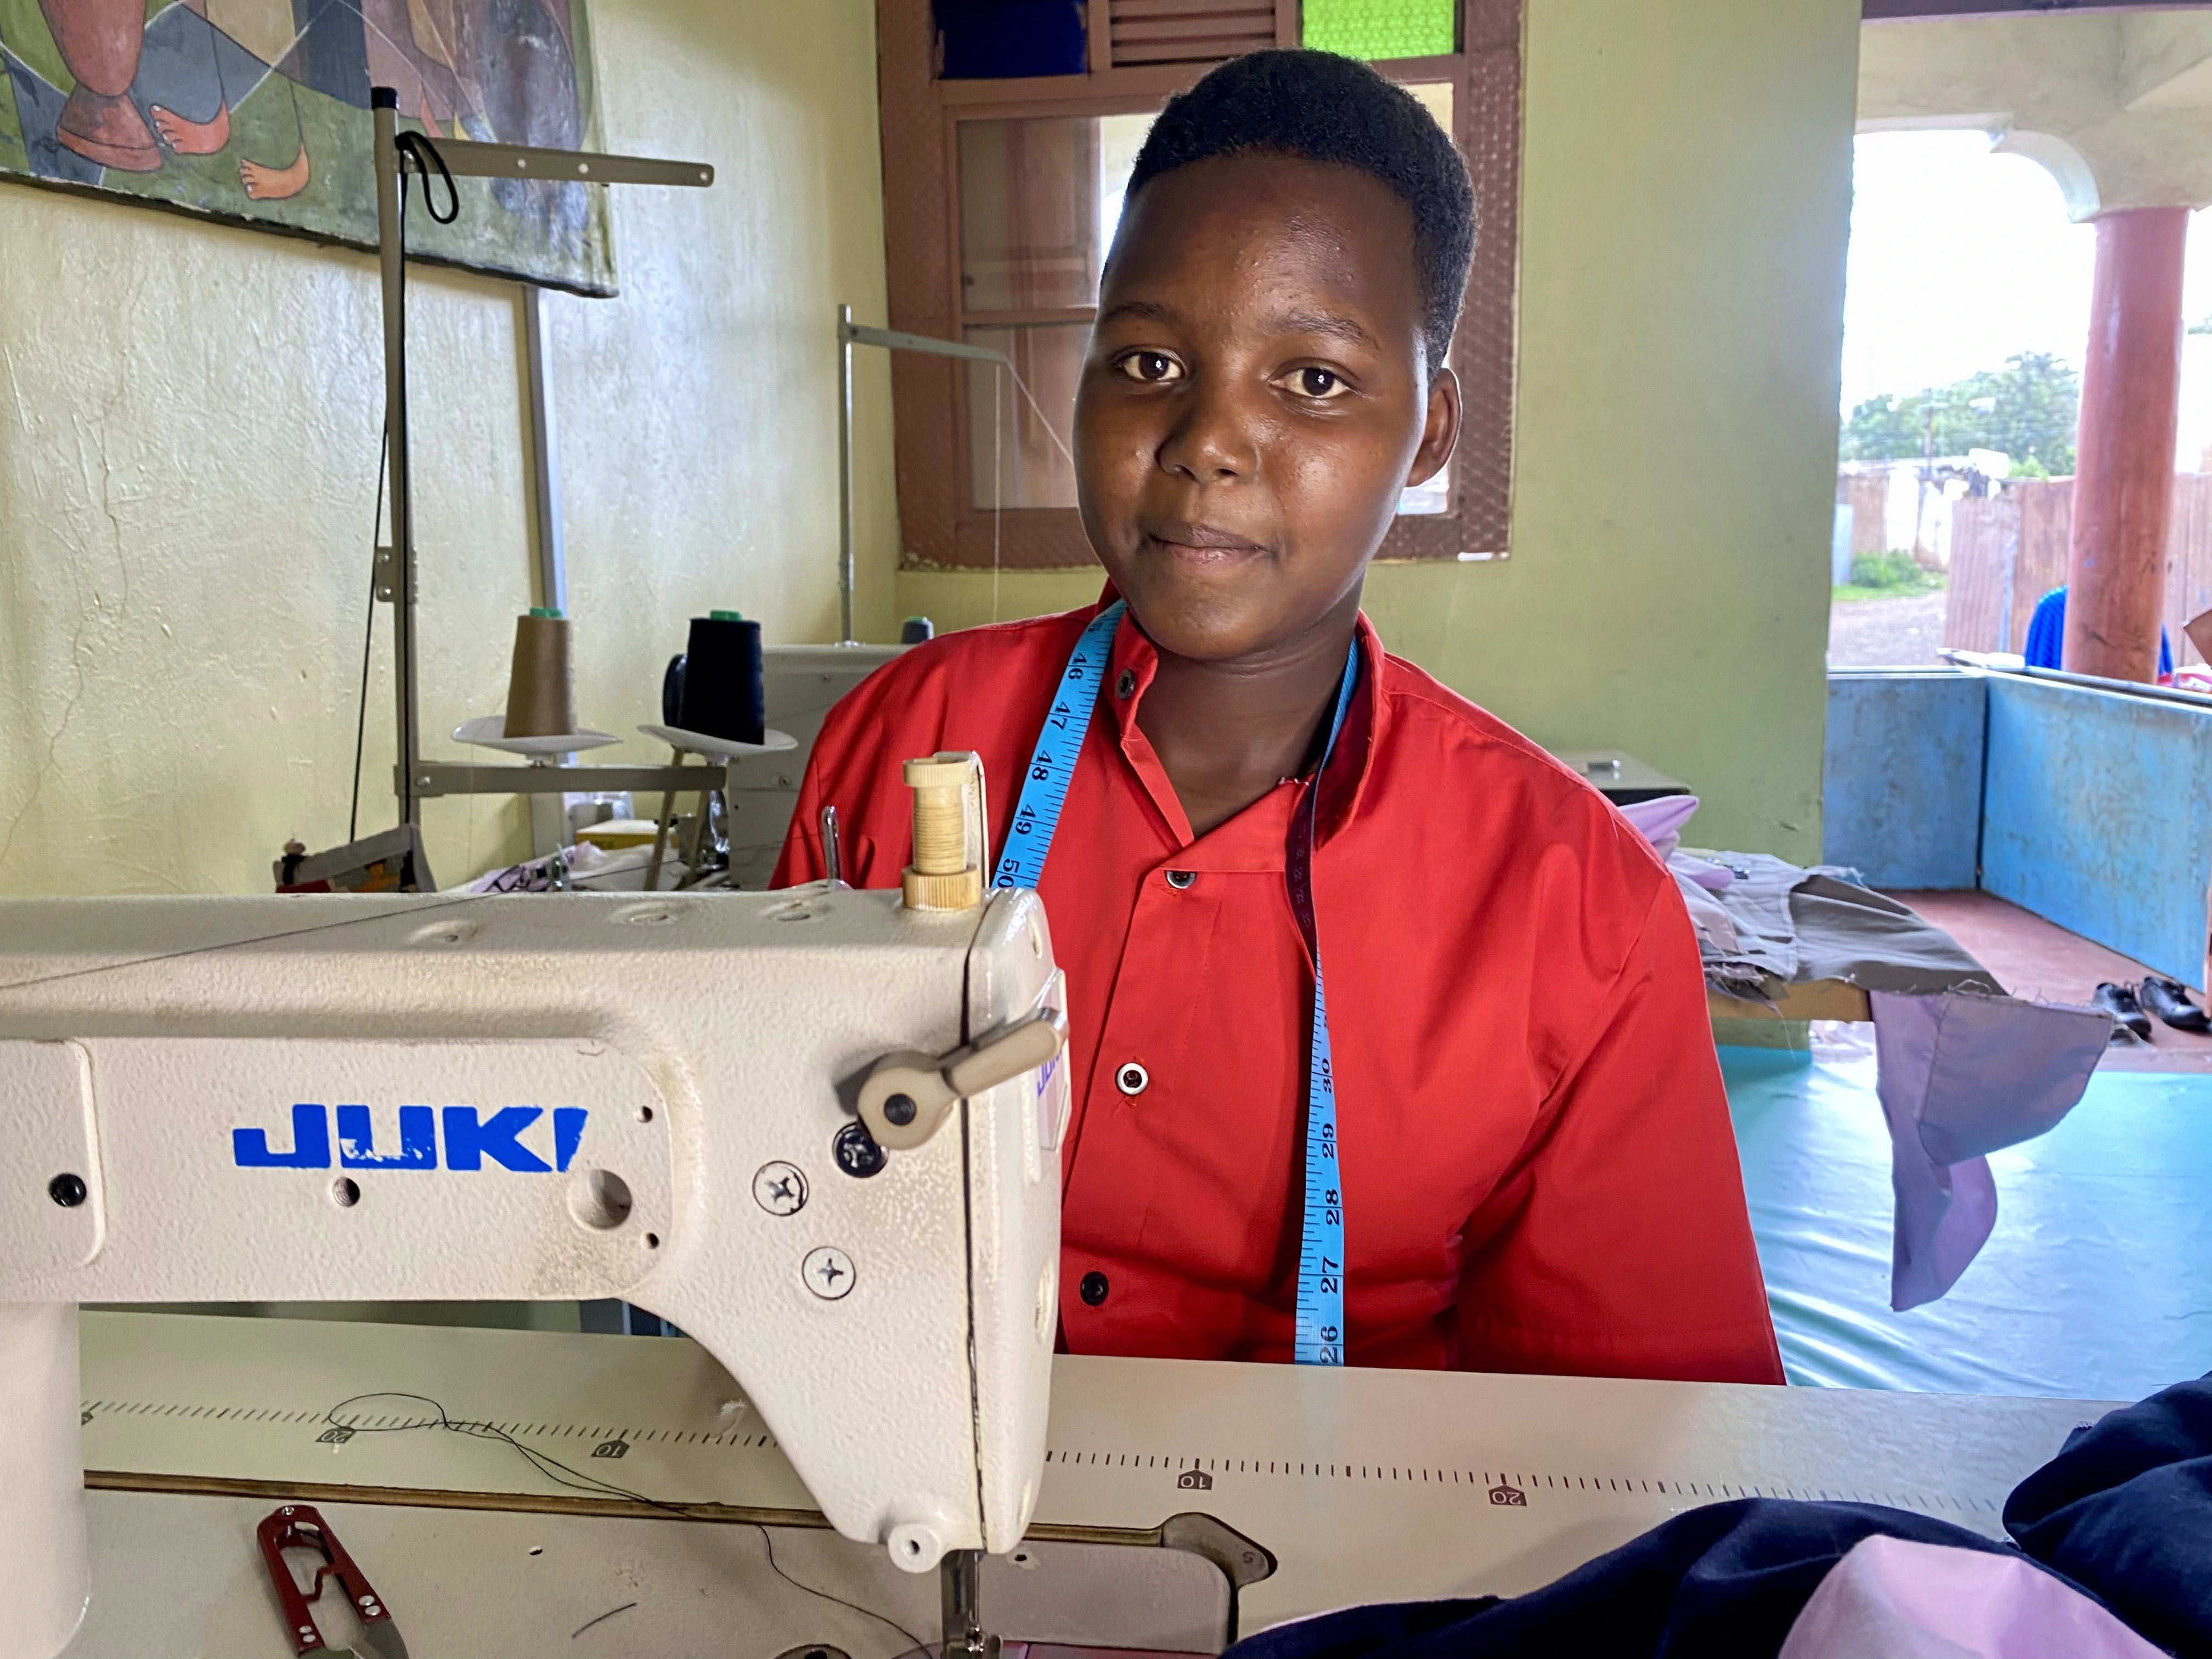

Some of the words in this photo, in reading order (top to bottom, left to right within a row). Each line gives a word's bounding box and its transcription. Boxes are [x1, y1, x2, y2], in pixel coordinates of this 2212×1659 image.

[1068, 652, 1087, 680] 46
[1050, 702, 1070, 730] 47
[1031, 749, 1053, 781] 48
[1015, 803, 1036, 835] 49
[997, 857, 1019, 888] 50
[1322, 1058, 1332, 1094] 30
[232, 1104, 588, 1172] JUKI
[1322, 1123, 1334, 1159] 29
[1325, 1189, 1340, 1226] 28
[1321, 1256, 1339, 1294] 27
[1320, 1325, 1339, 1363] 26
[321, 1430, 352, 1442] 20
[596, 1444, 621, 1457] 10
[1181, 1476, 1206, 1488] 10
[1492, 1492, 1521, 1505] 20
